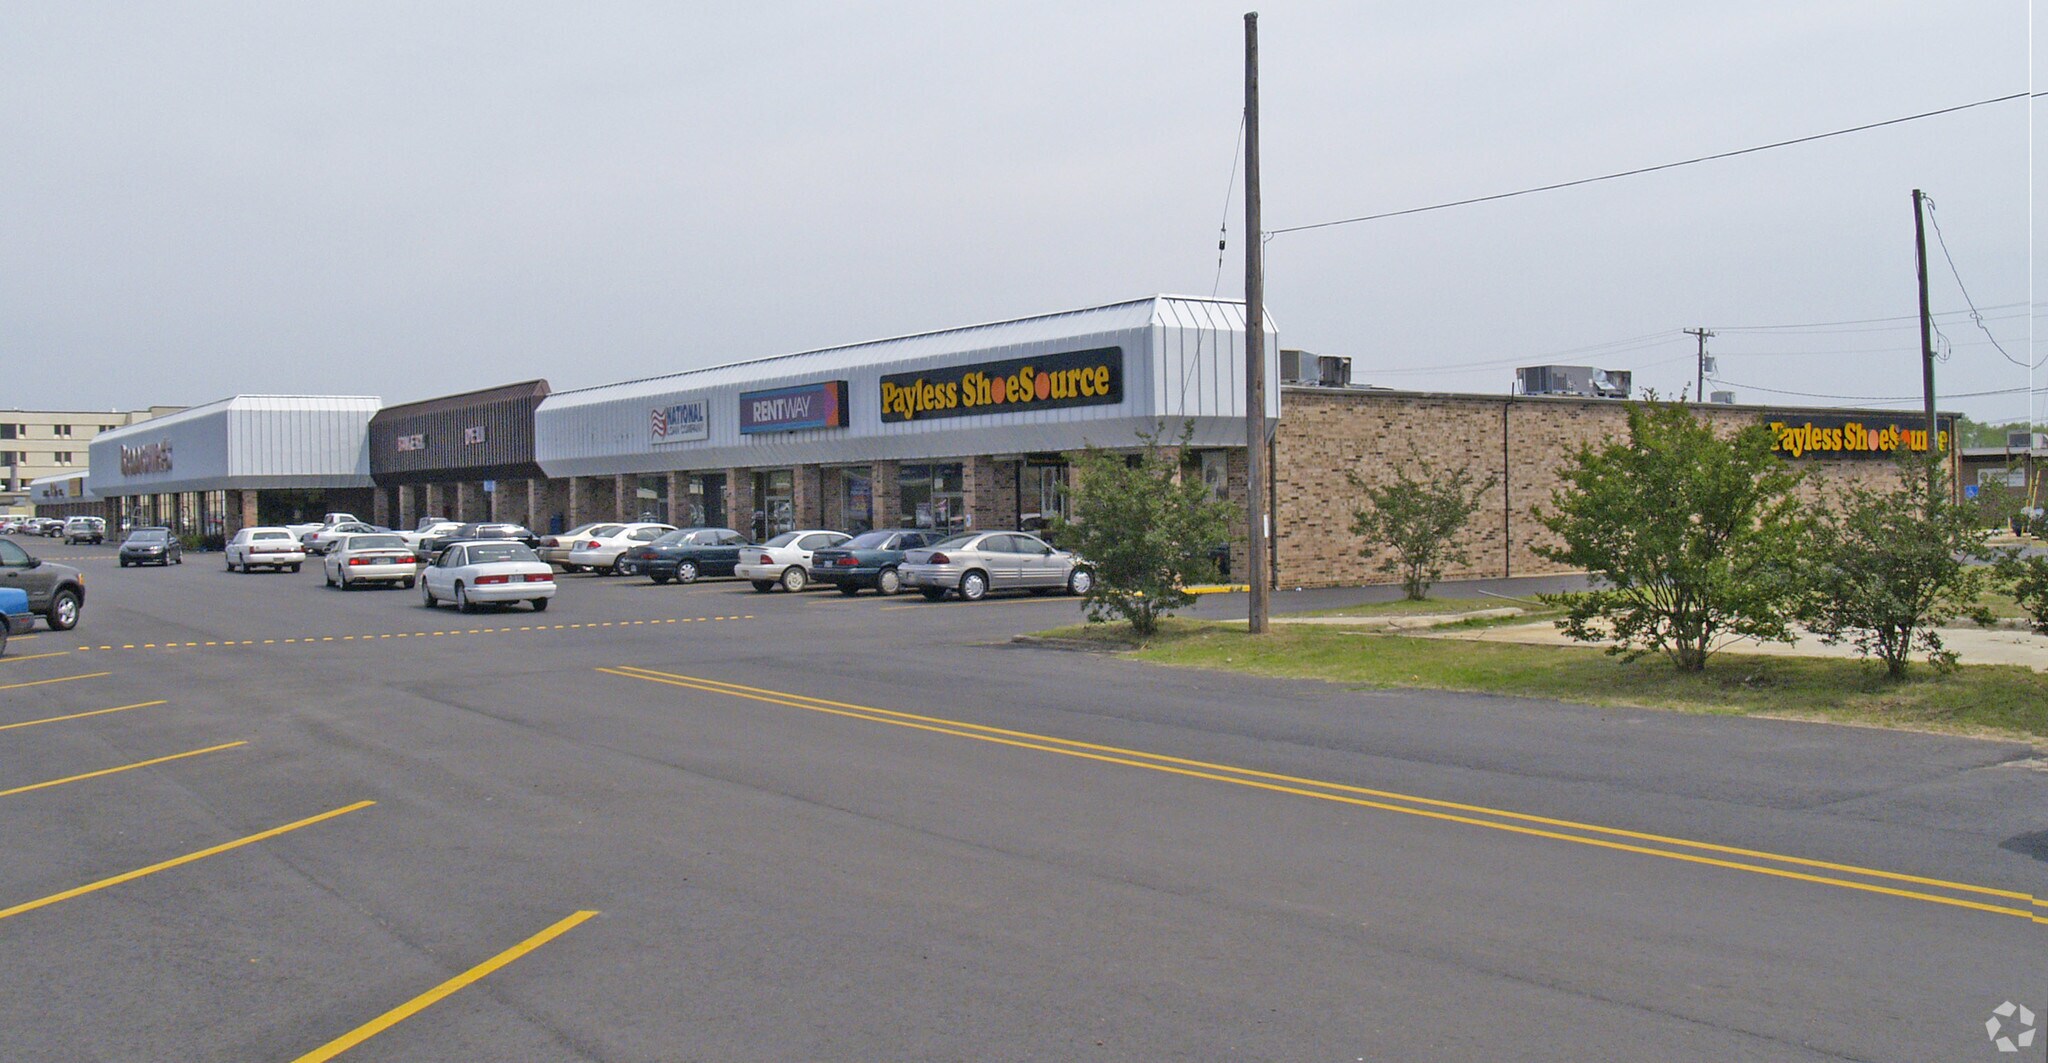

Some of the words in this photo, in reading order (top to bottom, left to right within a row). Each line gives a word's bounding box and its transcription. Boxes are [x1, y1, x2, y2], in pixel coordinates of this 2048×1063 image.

[881, 378, 957, 420] Payless
[962, 365, 1110, 407] ShoeSource
[667, 403, 703, 425] NATIONAL
[753, 396, 811, 422] RENTWAY
